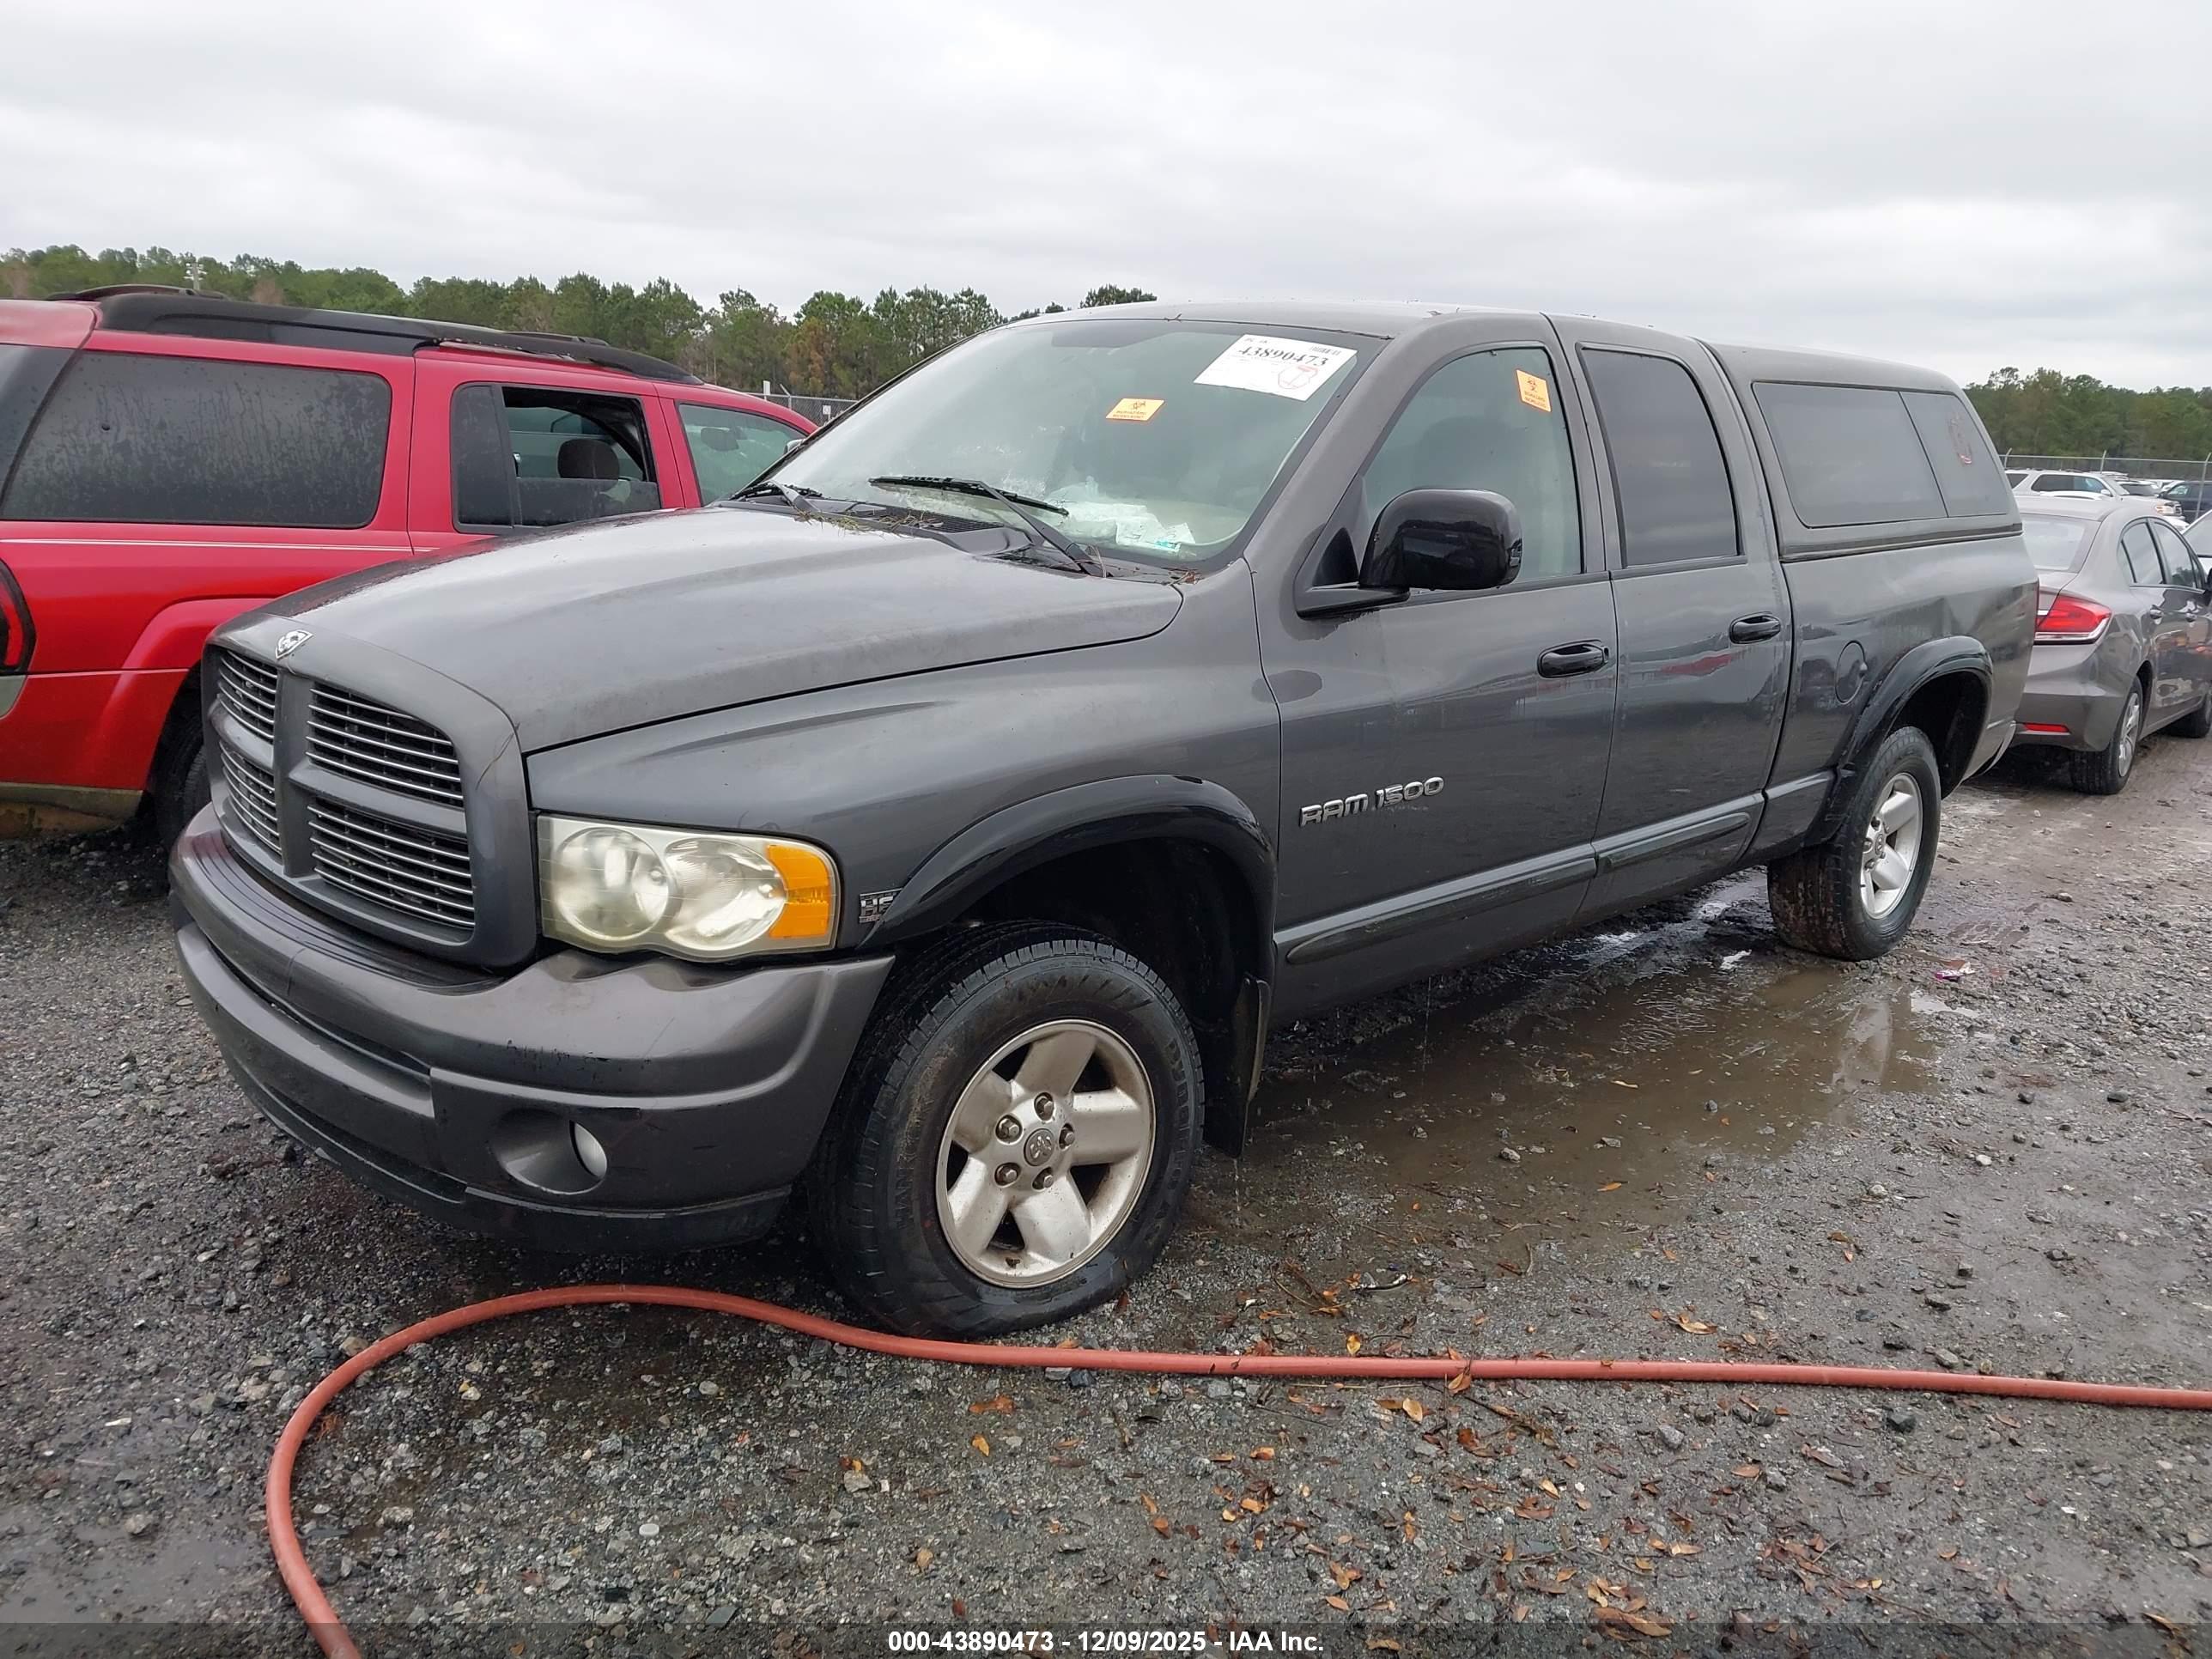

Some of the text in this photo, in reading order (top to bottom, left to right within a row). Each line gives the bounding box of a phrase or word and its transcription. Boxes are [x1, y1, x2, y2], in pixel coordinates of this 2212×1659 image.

[1238, 345, 1330, 368] 43890473
[1298, 776, 1445, 828] RAM 1500
